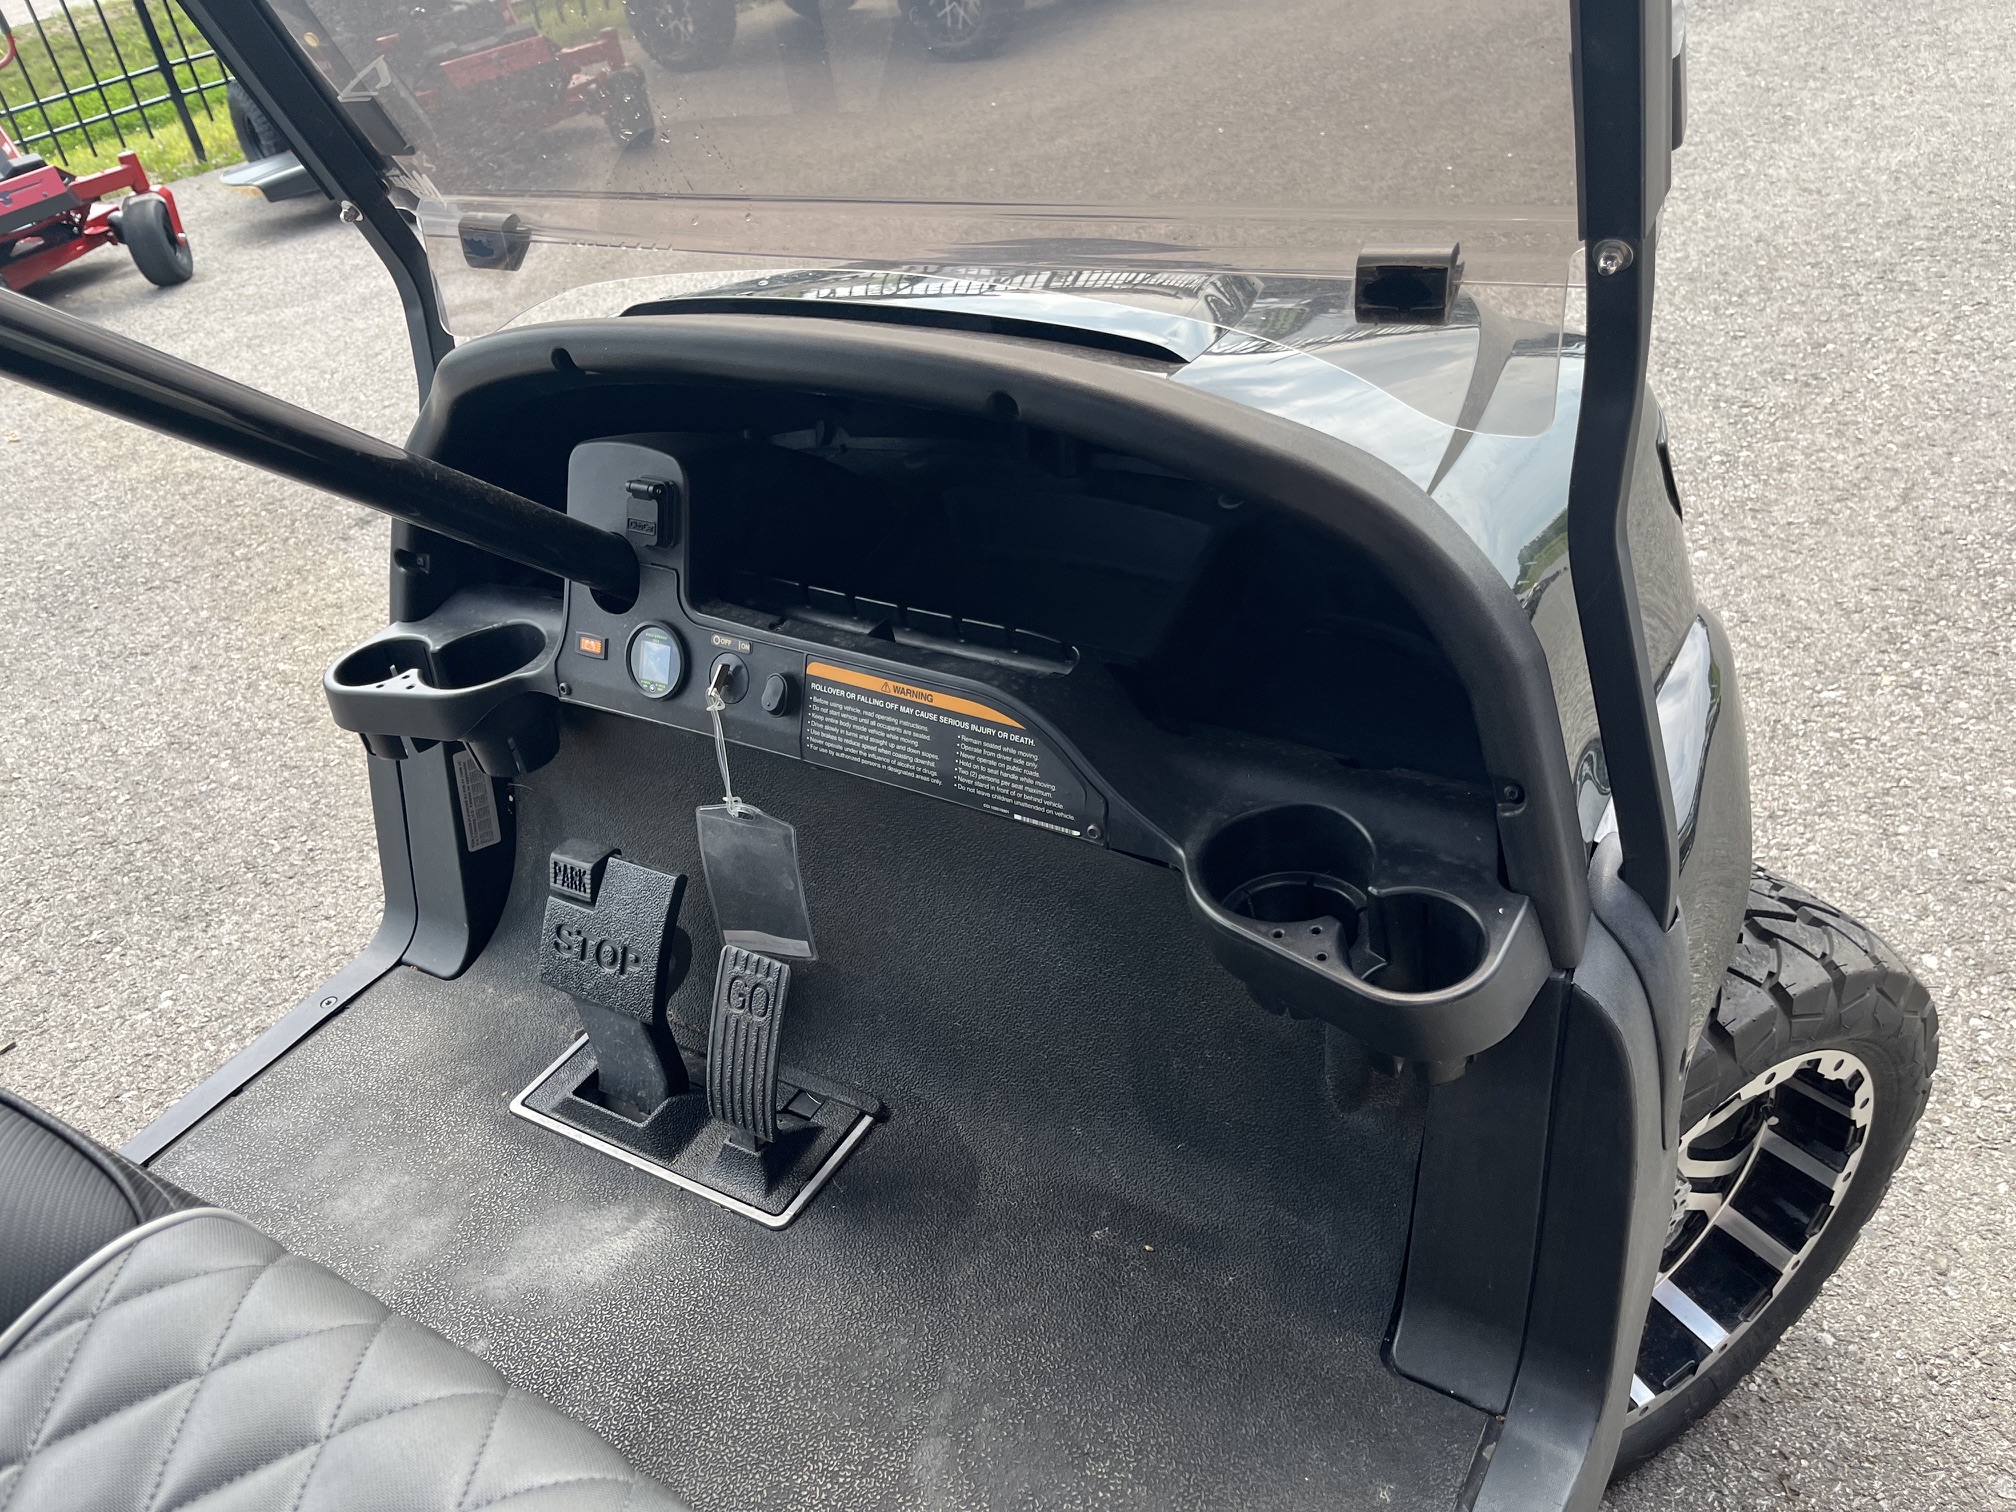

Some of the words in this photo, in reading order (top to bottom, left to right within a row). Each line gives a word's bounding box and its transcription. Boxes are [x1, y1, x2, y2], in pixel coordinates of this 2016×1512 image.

[721, 638, 732, 646] OFF
[741, 643, 750, 651] ON
[893, 685, 934, 703] WARNING
[811, 682, 845, 697] ROLLOVER
[846, 691, 856, 700] OR
[857, 694, 884, 707] FALLING
[885, 701, 899, 711] OFF
[900, 705, 914, 715] MAY
[915, 709, 938, 721] CAUSE
[939, 715, 969, 729] SERIOUS
[970, 723, 996, 736] INJURY
[997, 730, 1008, 740] OR
[1010, 733, 1035, 747] DEATH.
[813, 696, 829, 705] Before
[830, 701, 843, 711] using
[863, 710, 874, 718] read
[875, 713, 898, 725] operating
[829, 709, 840, 717] start
[841, 712, 858, 722] vehicle
[859, 717, 869, 725] until
[877, 722, 902, 733] occupants
[811, 720, 823, 729] Drive
[824, 724, 839, 734] slowly
[840, 727, 845, 735] in
[846, 729, 858, 738] turns
[869, 736, 887, 746] straight
[889, 742, 895, 750] up
[907, 746, 920, 755] down
[812, 712, 824, 722] Keep
[825, 716, 838, 725] entire
[840, 719, 851, 729] body
[852, 723, 867, 732] inside
[868, 728, 885, 737] vehicle
[886, 732, 899, 741] while
[810, 728, 820, 736] Use
[821, 731, 837, 741] brakes
[844, 738, 860, 747] reduce
[862, 743, 877, 752] speed
[878, 747, 891, 756] when
[892, 751, 913, 763] coasting
[810, 736, 824, 745] Never
[825, 741, 843, 750] operate
[844, 746, 858, 754] under
[859, 749, 867, 757] the
[868, 751, 890, 763] influence
[897, 760, 915, 770] alcohol
[961, 734, 982, 746] Remain
[983, 741, 1001, 751] seated
[1002, 746, 1016, 754] while
[961, 743, 982, 754] Operate
[983, 748, 995, 758] from
[997, 752, 1012, 762] driver
[1013, 757, 1024, 765] side
[810, 743, 818, 751] For
[829, 748, 834, 757] by
[861, 758, 881, 768] persons
[887, 764, 914, 777] designated
[915, 773, 930, 782] areas
[958, 767, 969, 776] Two
[978, 774, 1000, 784] persons
[959, 759, 971, 768] Hold
[1000, 770, 1019, 781] handle
[1020, 776, 1034, 785] while
[960, 750, 975, 760] Never
[977, 756, 997, 766] operate
[1006, 764, 1022, 773] public
[958, 775, 973, 785] Never
[974, 780, 989, 789] stand
[996, 785, 1009, 795] front
[1024, 793, 1042, 804] behind
[958, 783, 965, 791] Do
[976, 788, 990, 797] leave
[992, 793, 1013, 804] children
[1014, 800, 1045, 812] unattended
[553, 860, 588, 894] PARK
[553, 923, 643, 976] STOP
[728, 976, 768, 1018] GO
